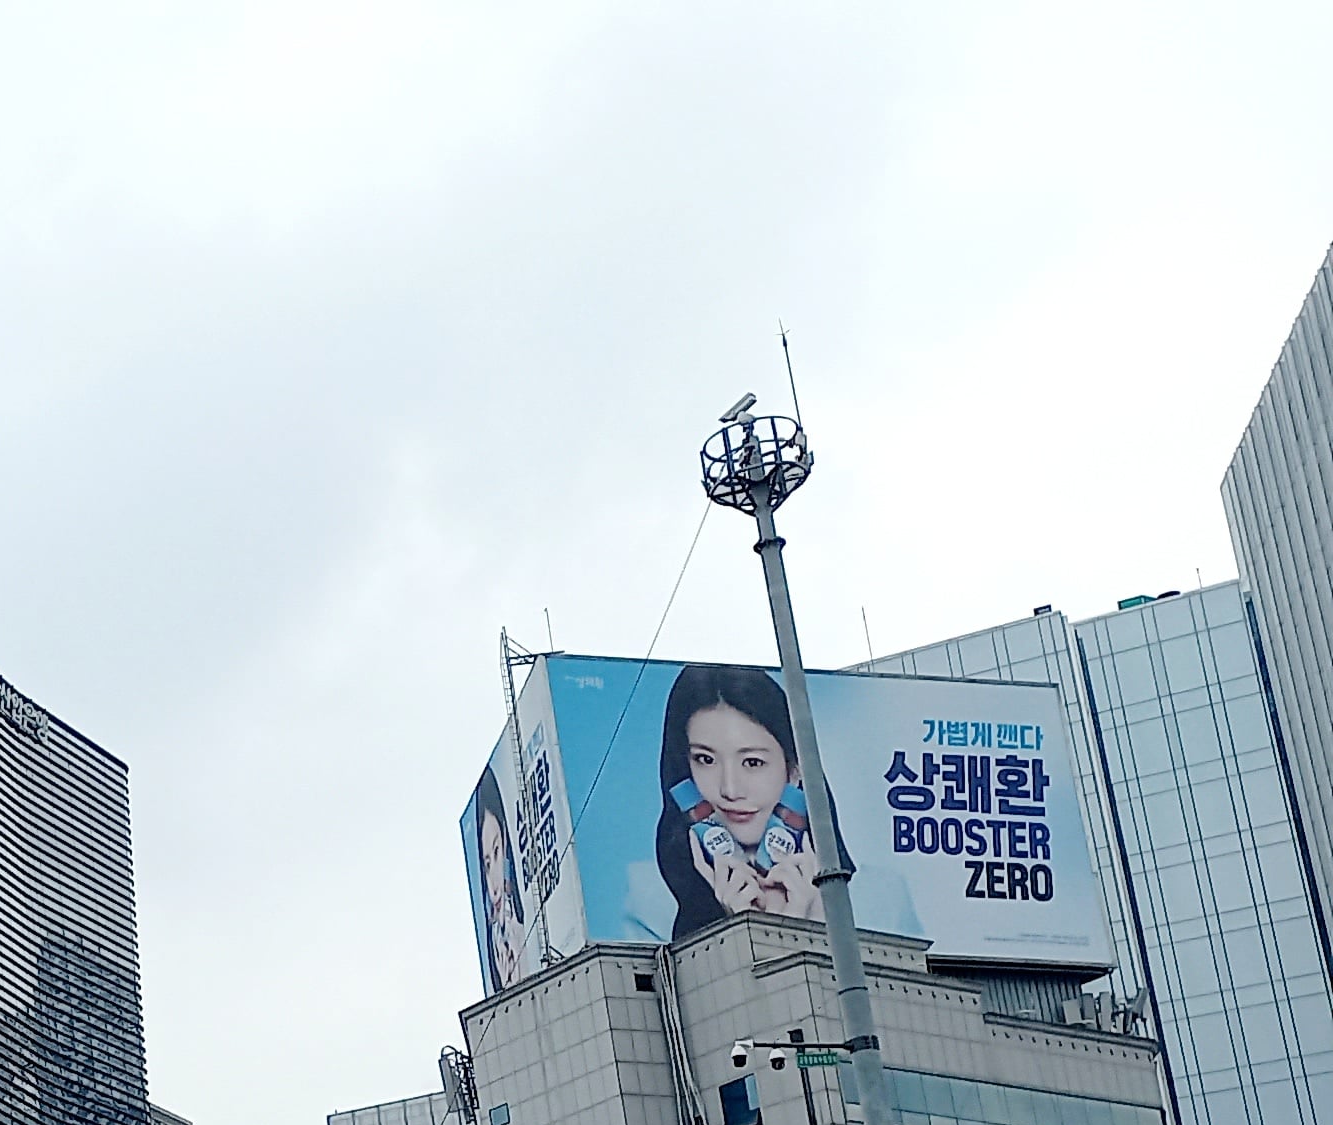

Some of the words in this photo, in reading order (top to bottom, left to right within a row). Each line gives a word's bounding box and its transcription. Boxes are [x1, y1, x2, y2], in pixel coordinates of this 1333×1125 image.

[922, 719, 992, 748] 가볍게
[996, 723, 1044, 751] 깬다
[883, 750, 1050, 817] 상쾌환
[893, 815, 1051, 860] BOOSTER
[965, 860, 1054, 902] ZERO
